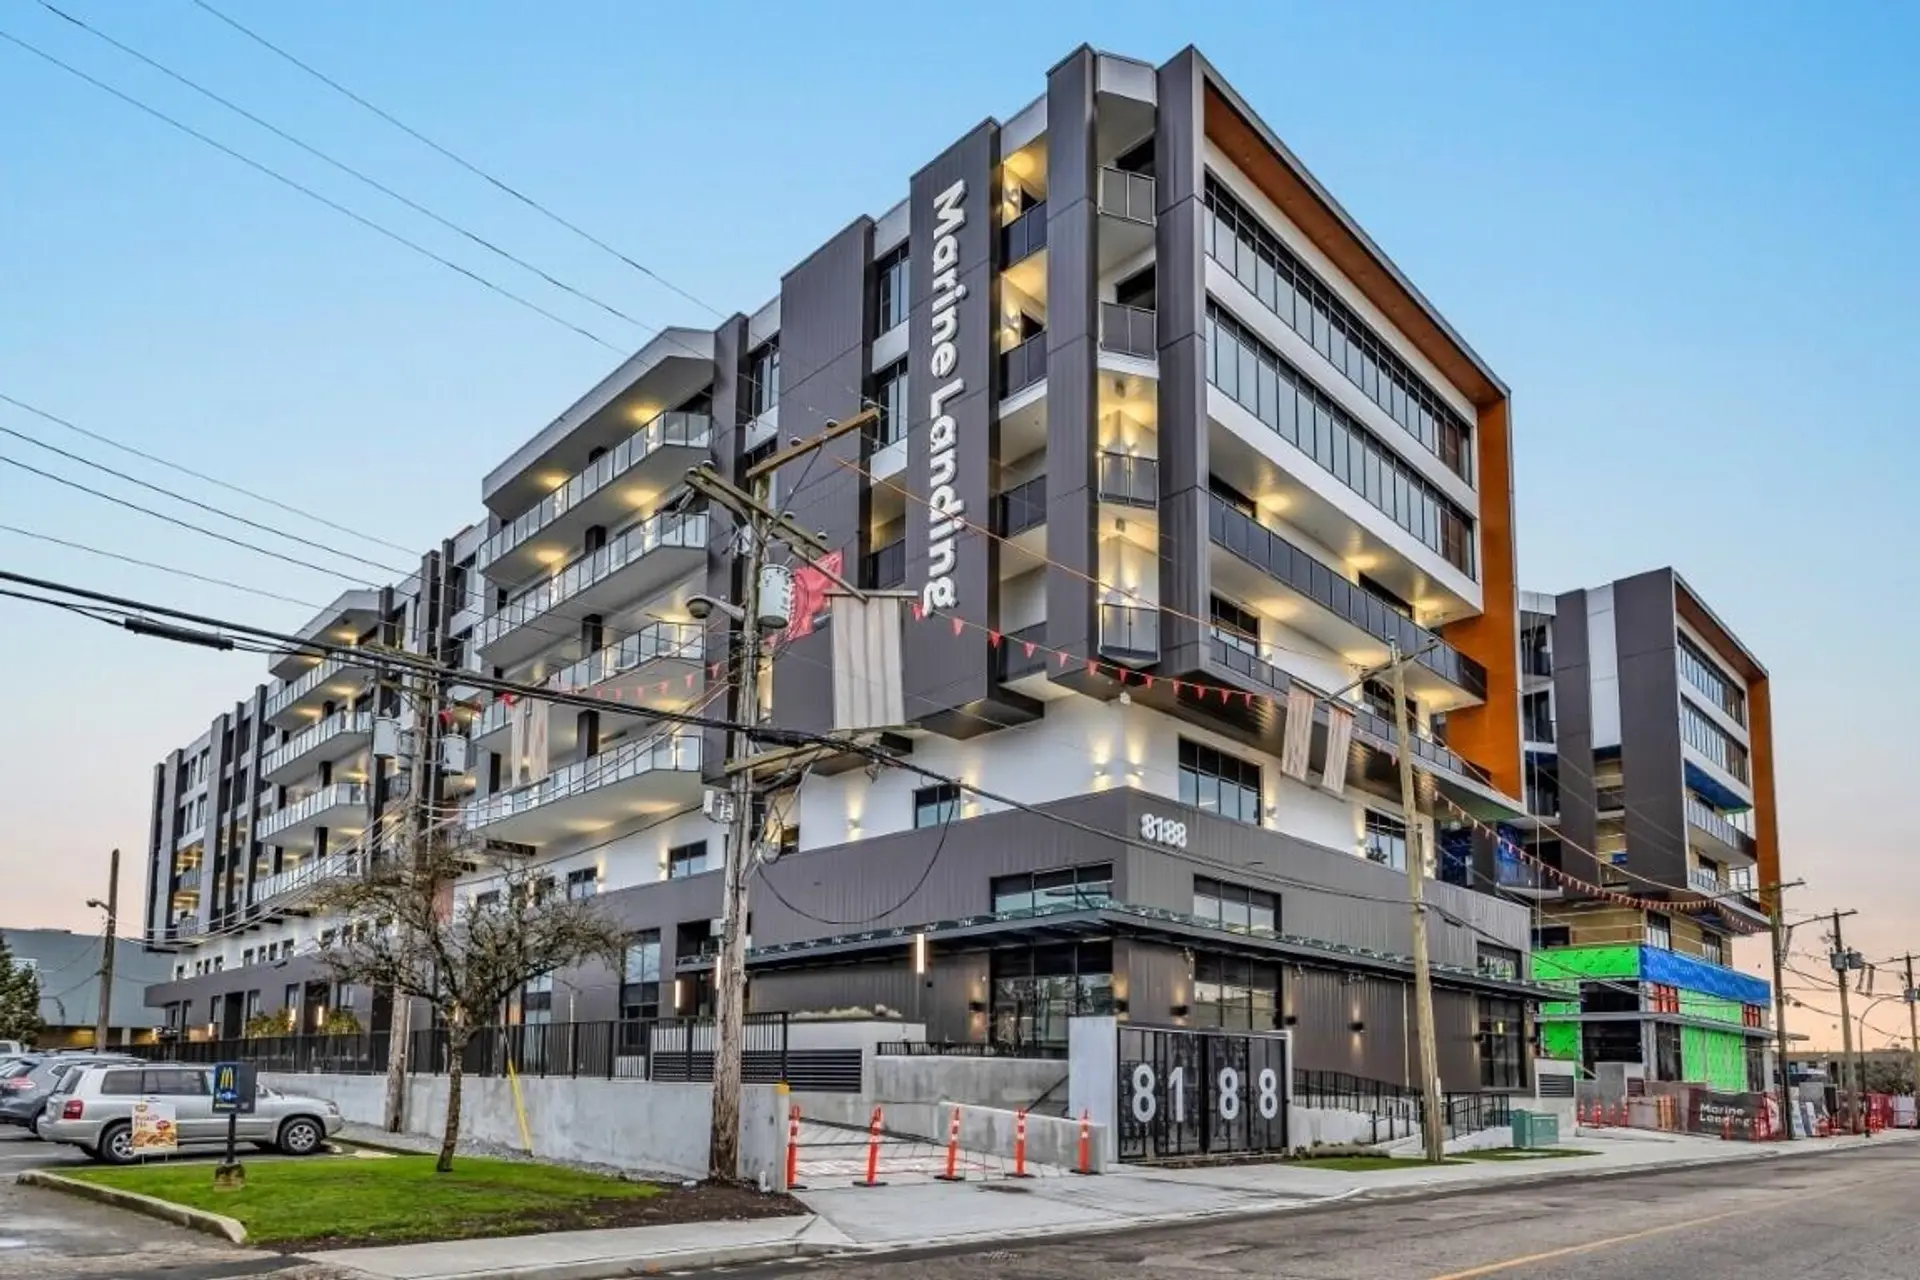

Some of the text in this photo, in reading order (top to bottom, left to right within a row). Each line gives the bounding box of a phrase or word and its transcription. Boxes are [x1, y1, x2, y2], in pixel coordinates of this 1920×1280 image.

[923, 178, 968, 618] Marine Landing
[1141, 813, 1187, 848] 8188
[1132, 1064, 1278, 1122] 8188
[1700, 1103, 1745, 1116] Marine
